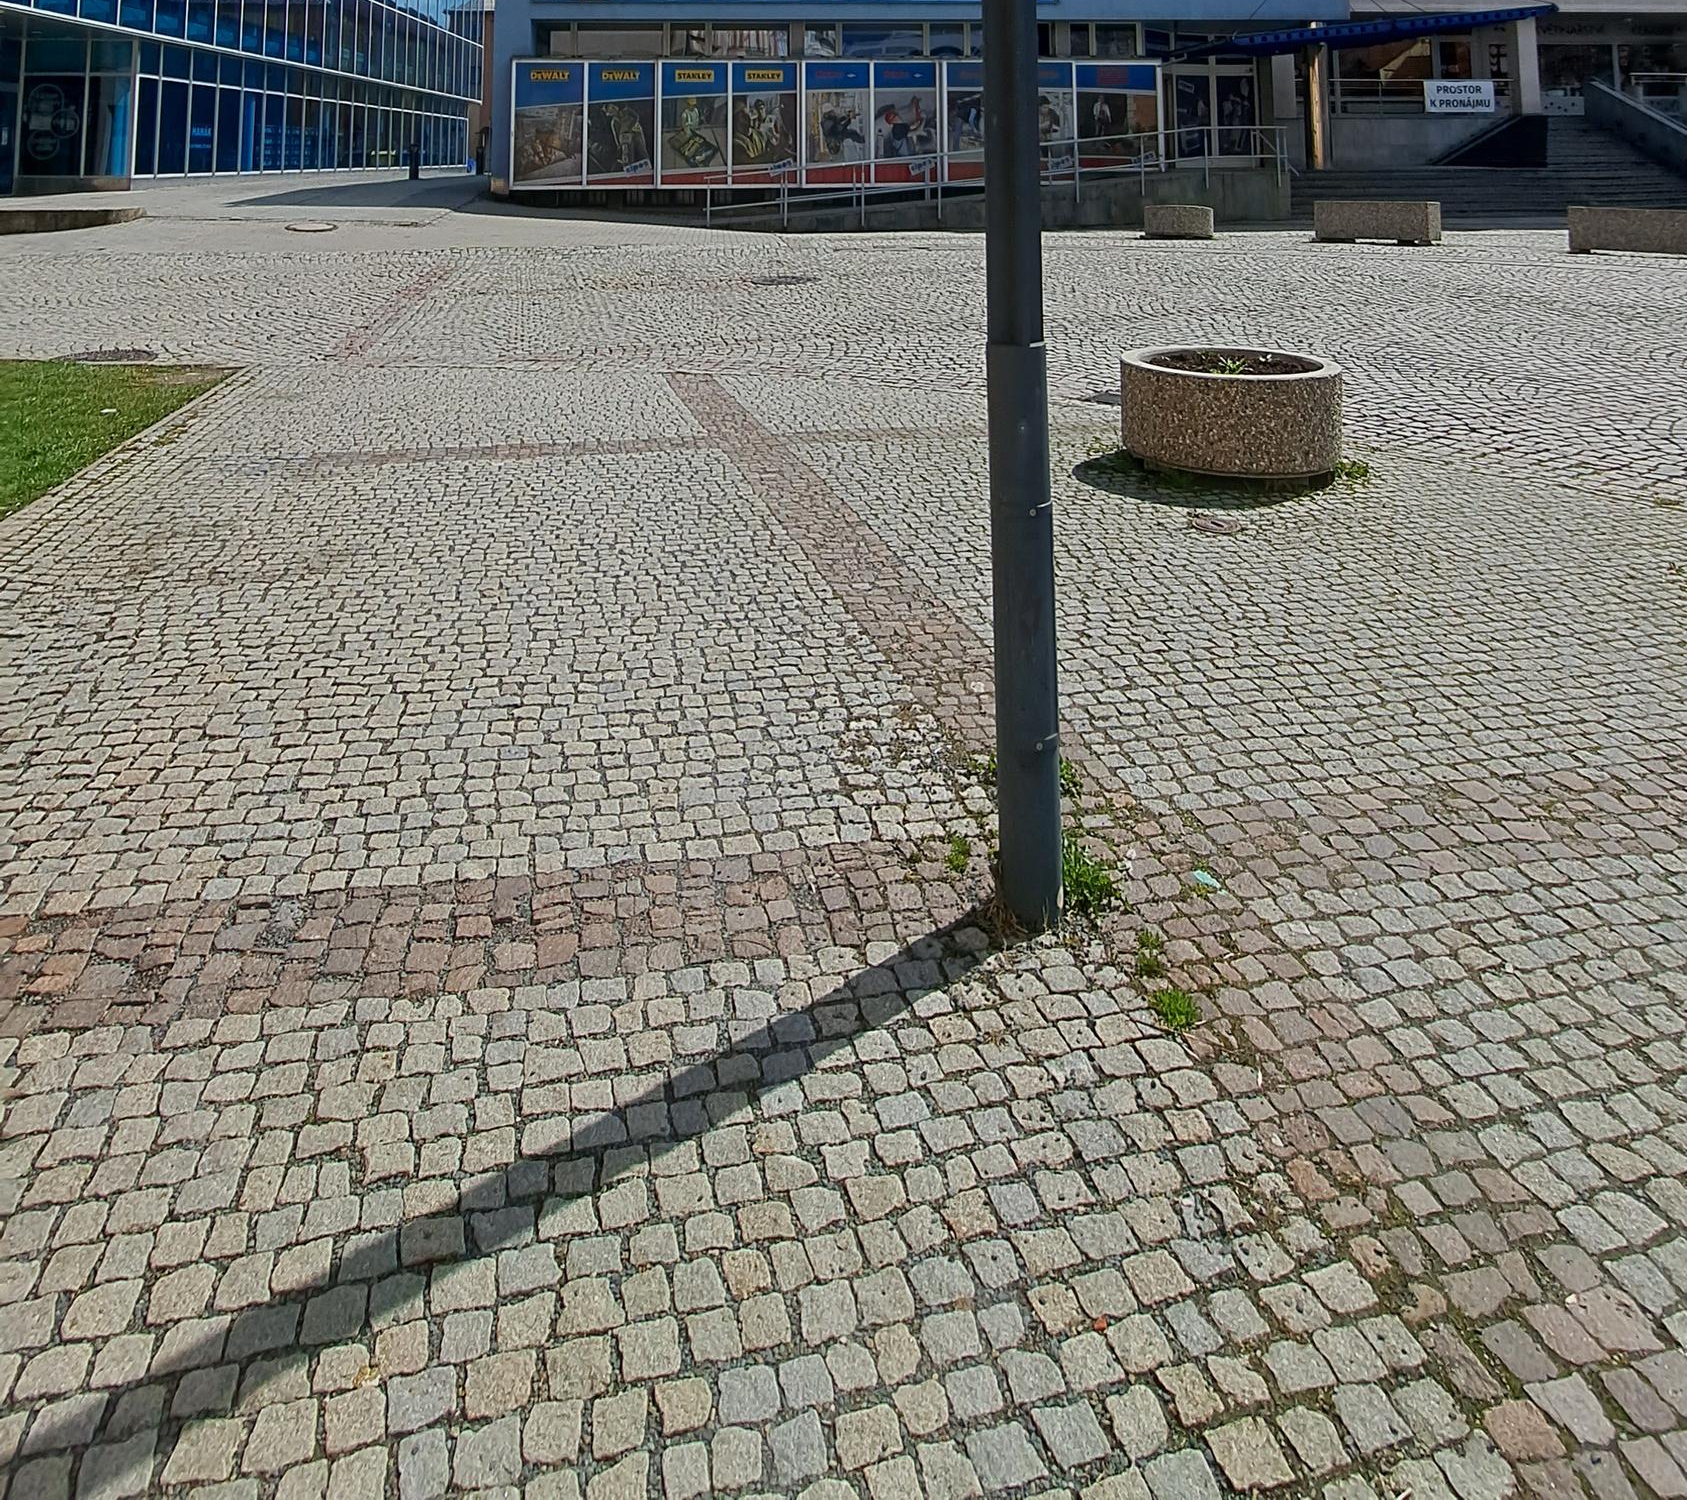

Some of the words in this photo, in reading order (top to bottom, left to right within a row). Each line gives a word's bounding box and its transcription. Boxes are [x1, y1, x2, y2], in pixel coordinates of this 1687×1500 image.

[677, 72, 712, 80] STANLEY
[747, 72, 781, 80] STANLEY
[1436, 85, 1482, 94] PROSTOR
[1430, 99, 1437, 108] K
[1439, 97, 1491, 109] PRONÁJMU
